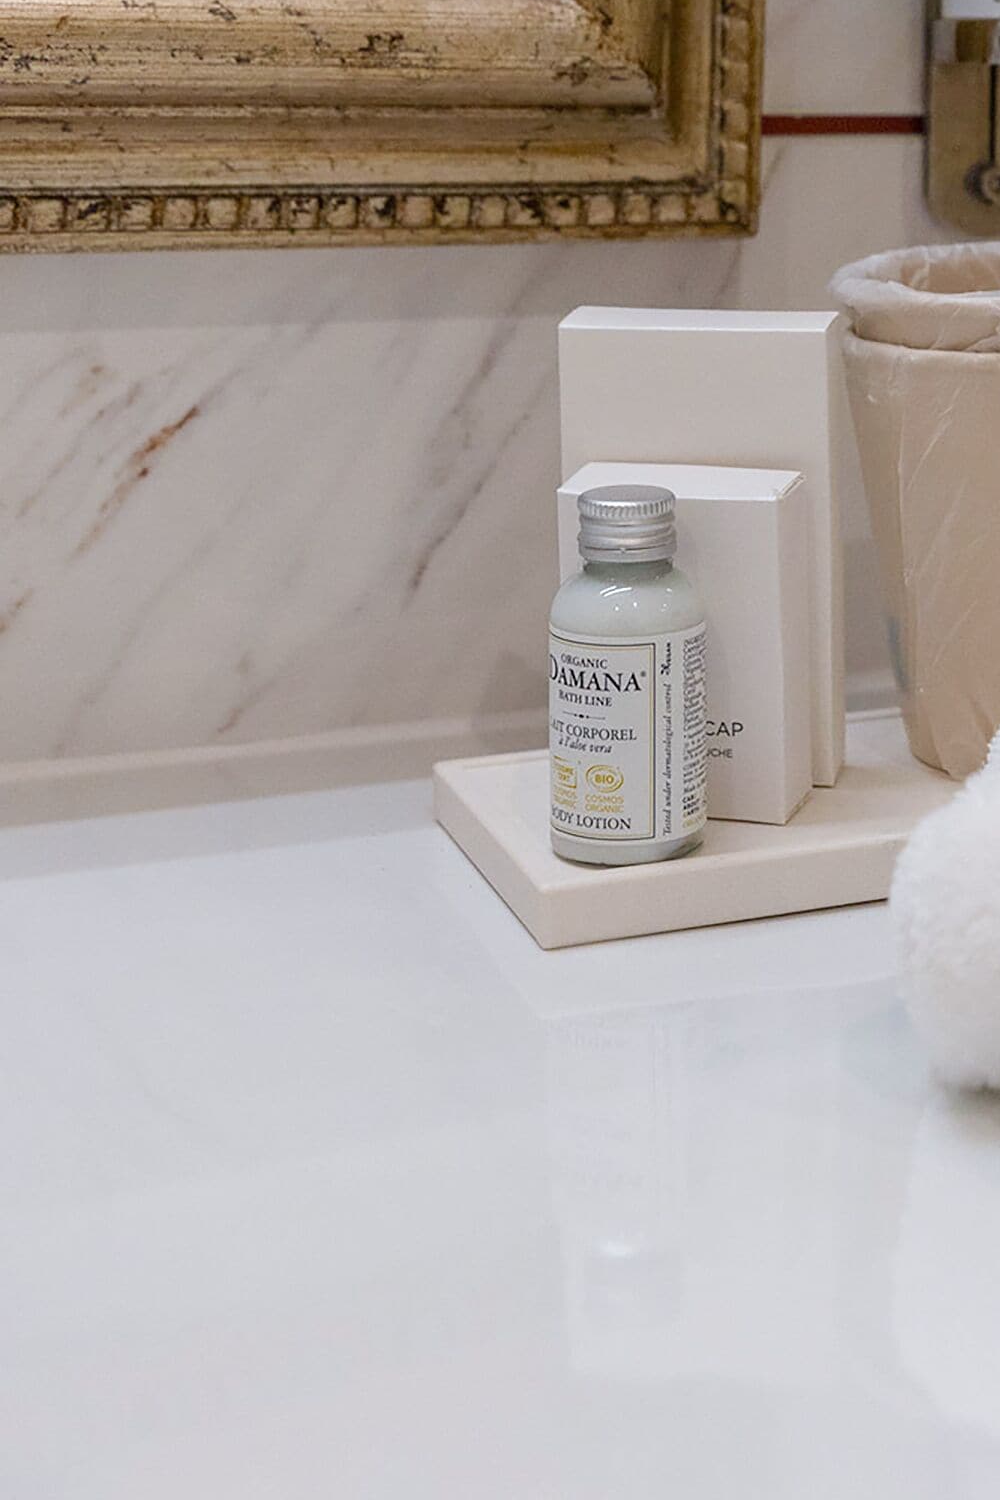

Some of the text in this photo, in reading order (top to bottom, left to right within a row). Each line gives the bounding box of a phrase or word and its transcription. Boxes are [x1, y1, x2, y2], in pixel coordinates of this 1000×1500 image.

[560, 653, 608, 669] ORGANIC
[558, 689, 613, 707] BATH LINE
[565, 722, 638, 741] CORPOREL
[705, 720, 743, 736] CAP
[594, 773, 615, 785] BIO
[576, 813, 632, 830] LOTION
